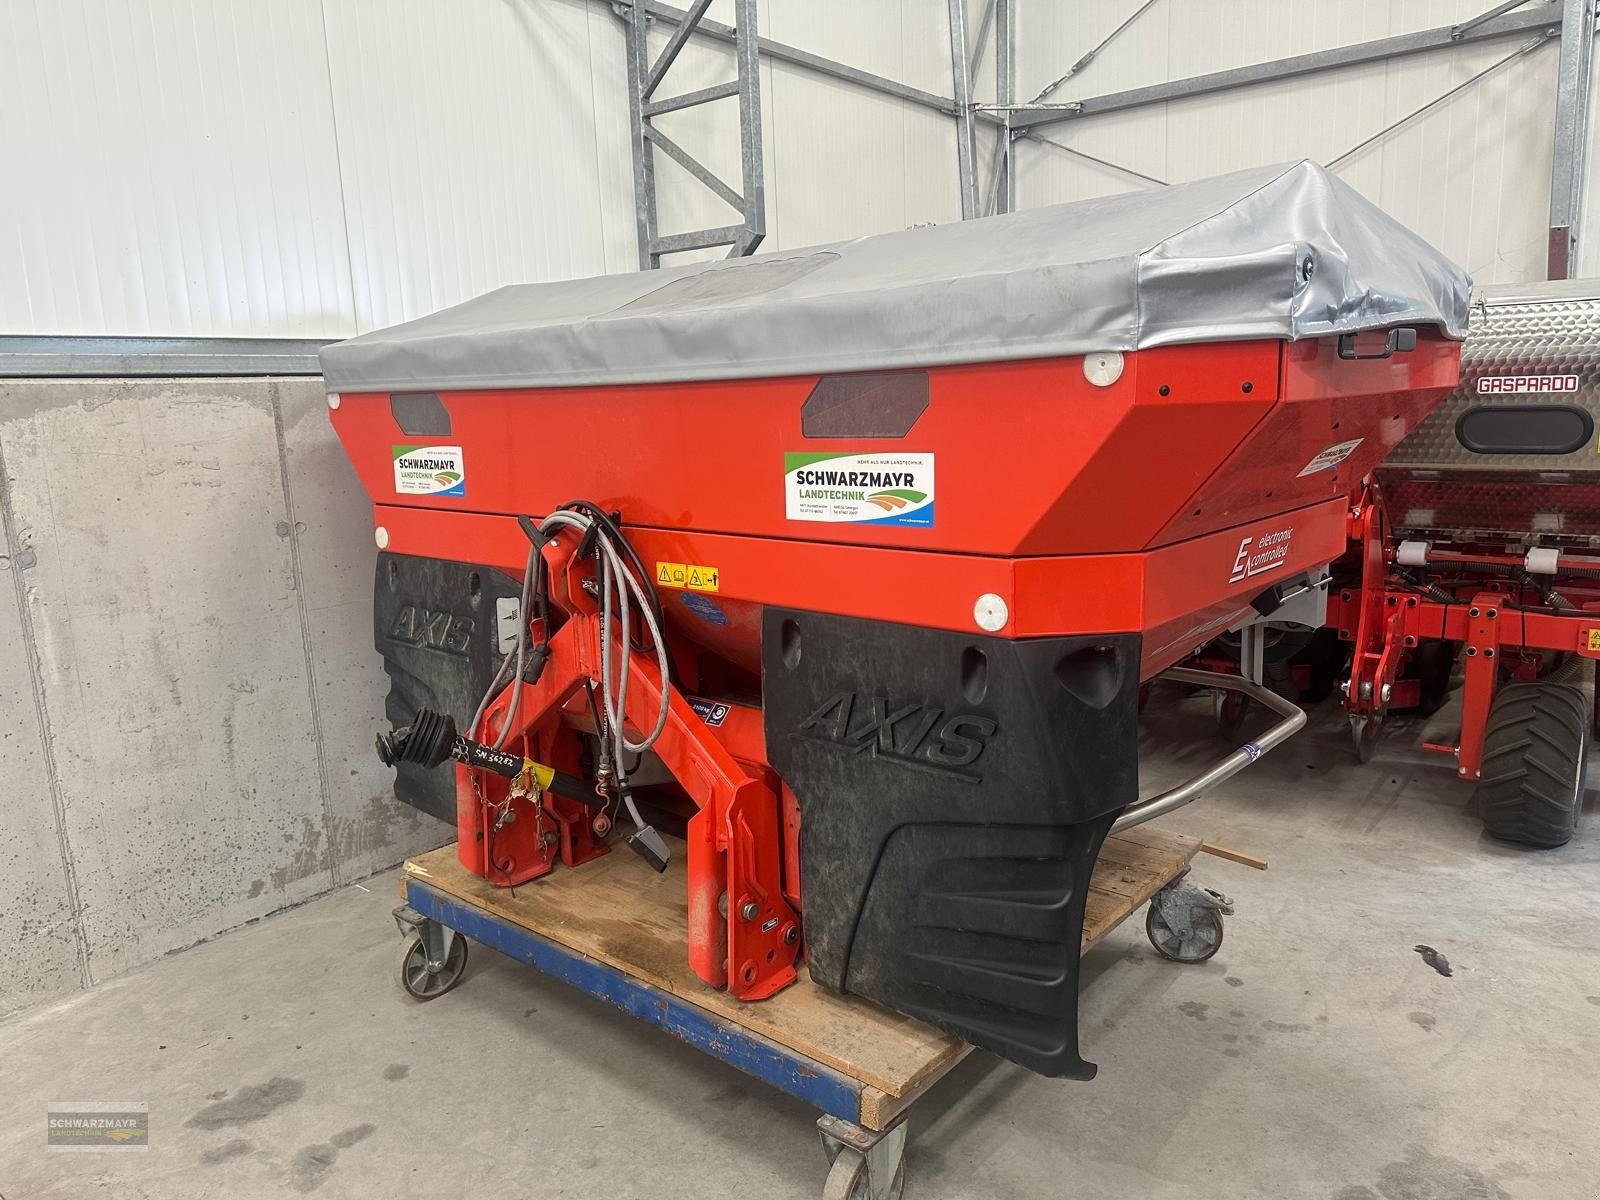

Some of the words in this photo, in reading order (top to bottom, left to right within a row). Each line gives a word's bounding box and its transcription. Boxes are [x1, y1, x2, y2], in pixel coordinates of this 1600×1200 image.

[1479, 376, 1577, 392] GASPARDO
[399, 459, 455, 470] SCHWARZMAYR
[796, 471, 914, 487] SCHWARZMAYR
[799, 489, 865, 501] LANDTECHNIK
[1258, 526, 1293, 549] electronic
[1250, 542, 1289, 567] controlled
[394, 607, 475, 652] AXIS
[799, 691, 998, 766] AXIS
